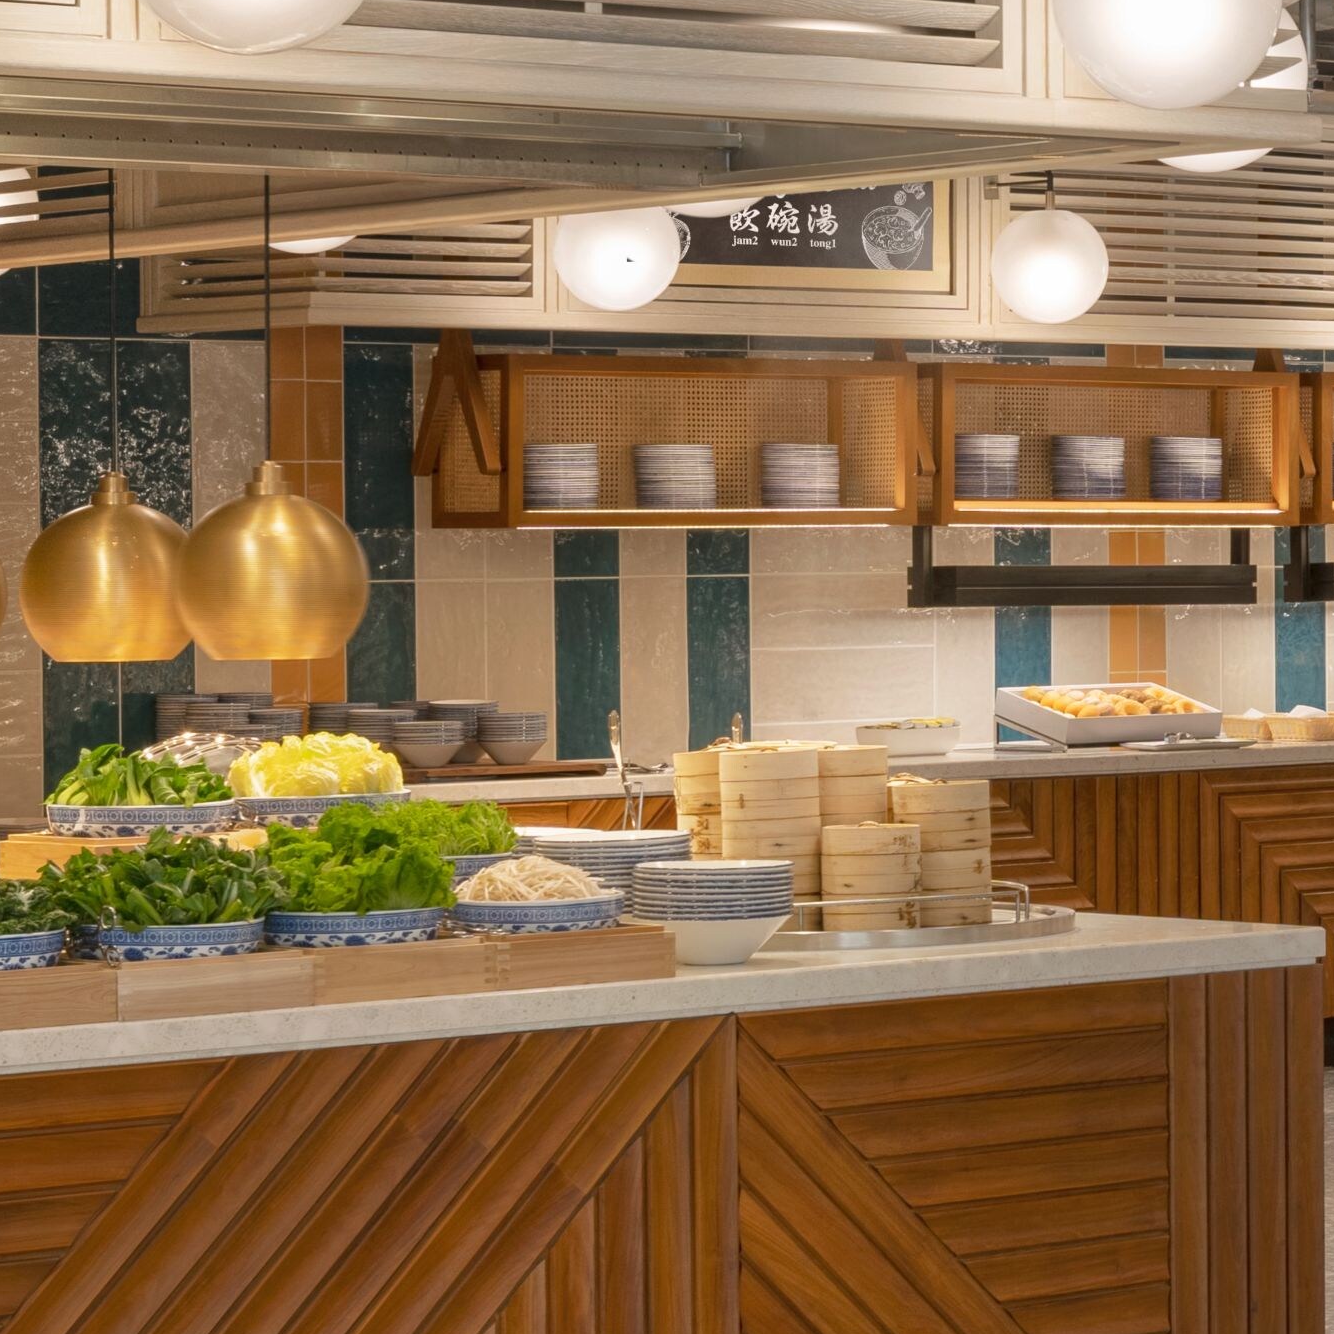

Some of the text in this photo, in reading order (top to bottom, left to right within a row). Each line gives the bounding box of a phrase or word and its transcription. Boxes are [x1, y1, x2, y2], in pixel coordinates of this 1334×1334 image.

[731, 235, 837, 250] jam2 wun2 tong1
